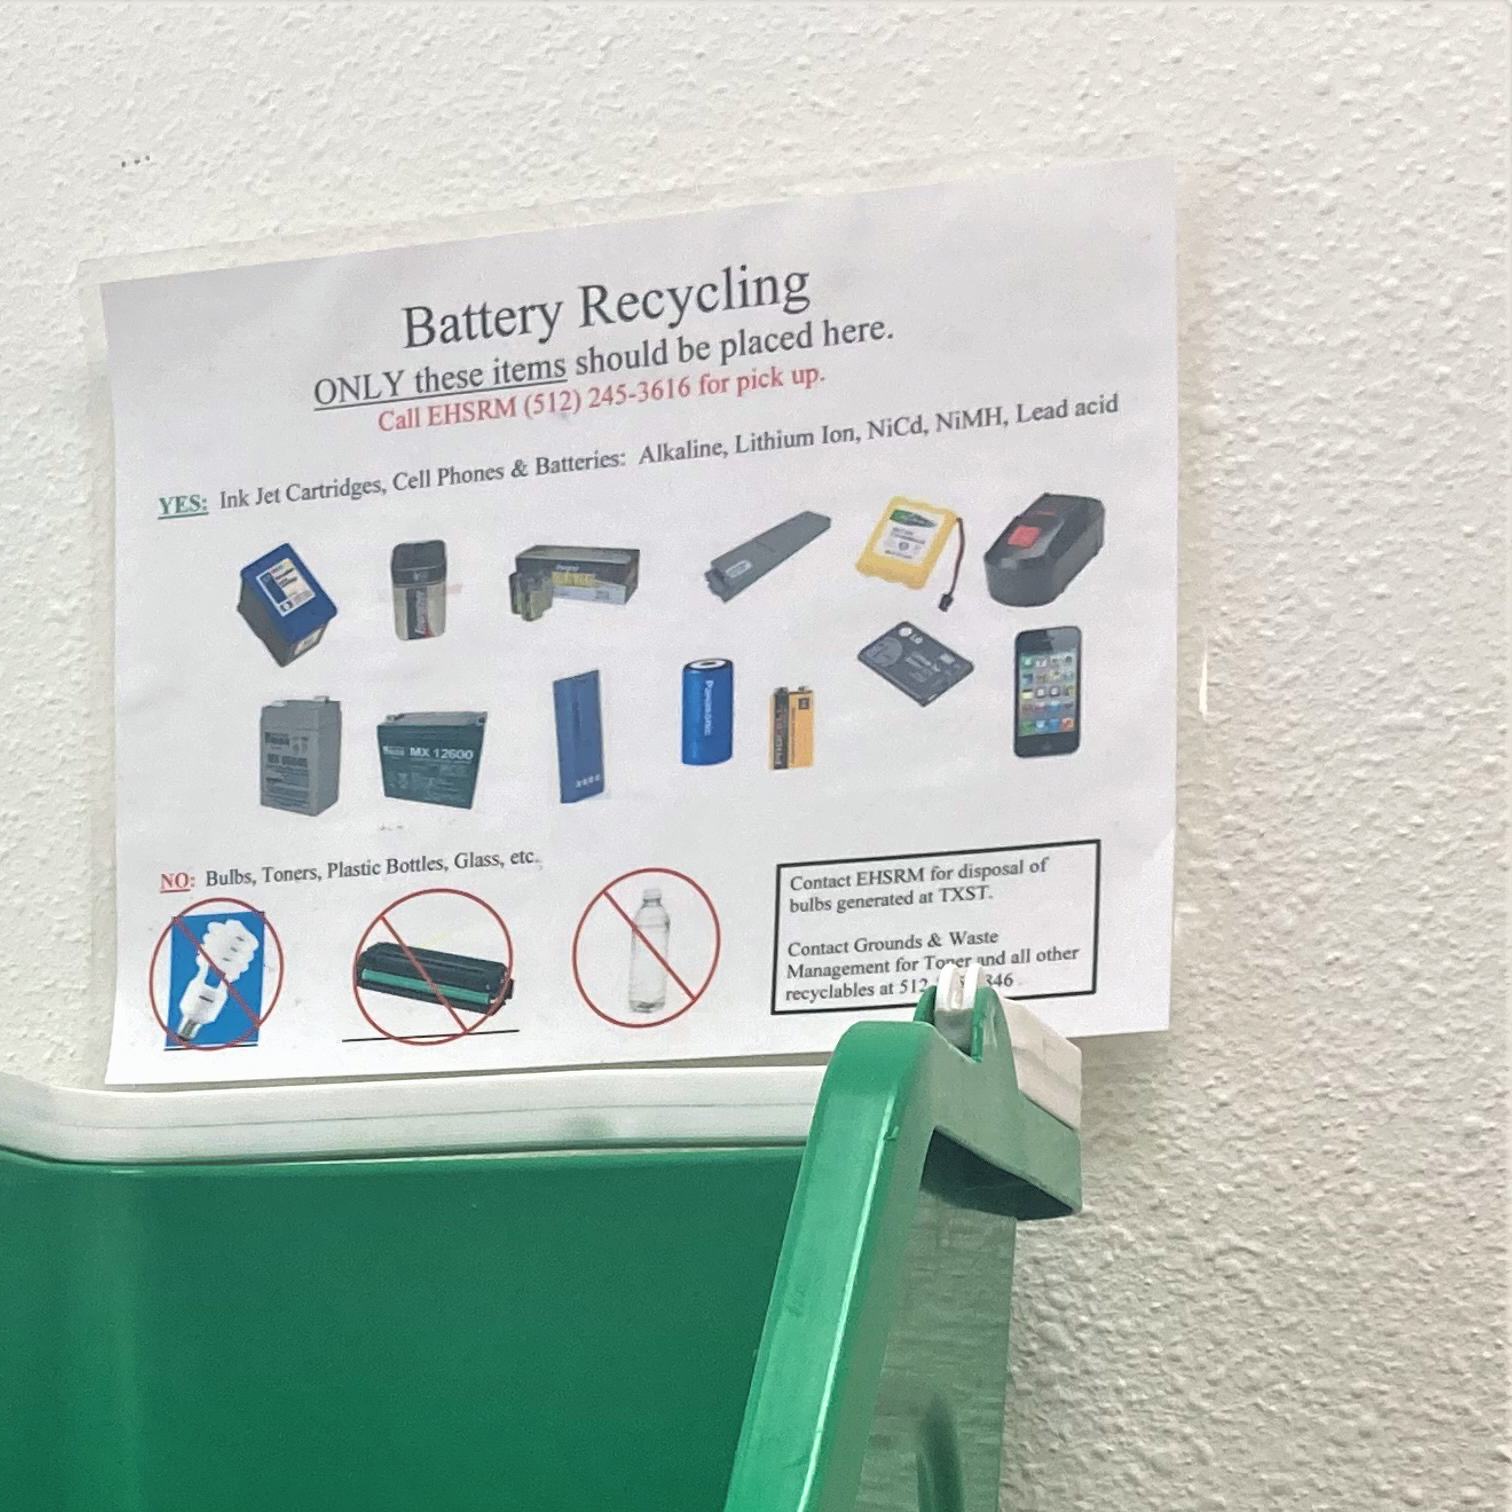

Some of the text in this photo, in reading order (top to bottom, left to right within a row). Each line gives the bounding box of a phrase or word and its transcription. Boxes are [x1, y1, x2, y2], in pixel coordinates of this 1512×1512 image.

[401, 264, 810, 349] Battery Recycling
[314, 319, 894, 406] ONLY these items should be placed here.
[378, 366, 826, 432] Call EHSRM (512) 245-3616 for pick up.
[159, 393, 1119, 517] YES: Ink Jet Cartridges, Cell Phones & Batteries: Alkaline, Lithium Ion, NiCd, NiMH, Lead acid
[410, 747, 430, 757] MX
[160, 872, 195, 890] NO:
[206, 869, 257, 887] Bulbs,
[261, 866, 322, 883] Toners,
[327, 859, 381, 879] Plastic
[387, 855, 449, 875] Bottles,
[454, 852, 505, 869] Glass,
[790, 856, 1050, 891] Contact EHSRM for disposal of
[790, 885, 993, 914] bulbs generated at TXST.
[788, 930, 999, 957] Contact Grounds & Waste
[787, 960, 890, 980] Management
[895, 956, 920, 972] for
[1011, 948, 1030, 964] all
[1036, 946, 1080, 962] other
[786, 982, 875, 1004] recyclables
[880, 983, 894, 995] at
